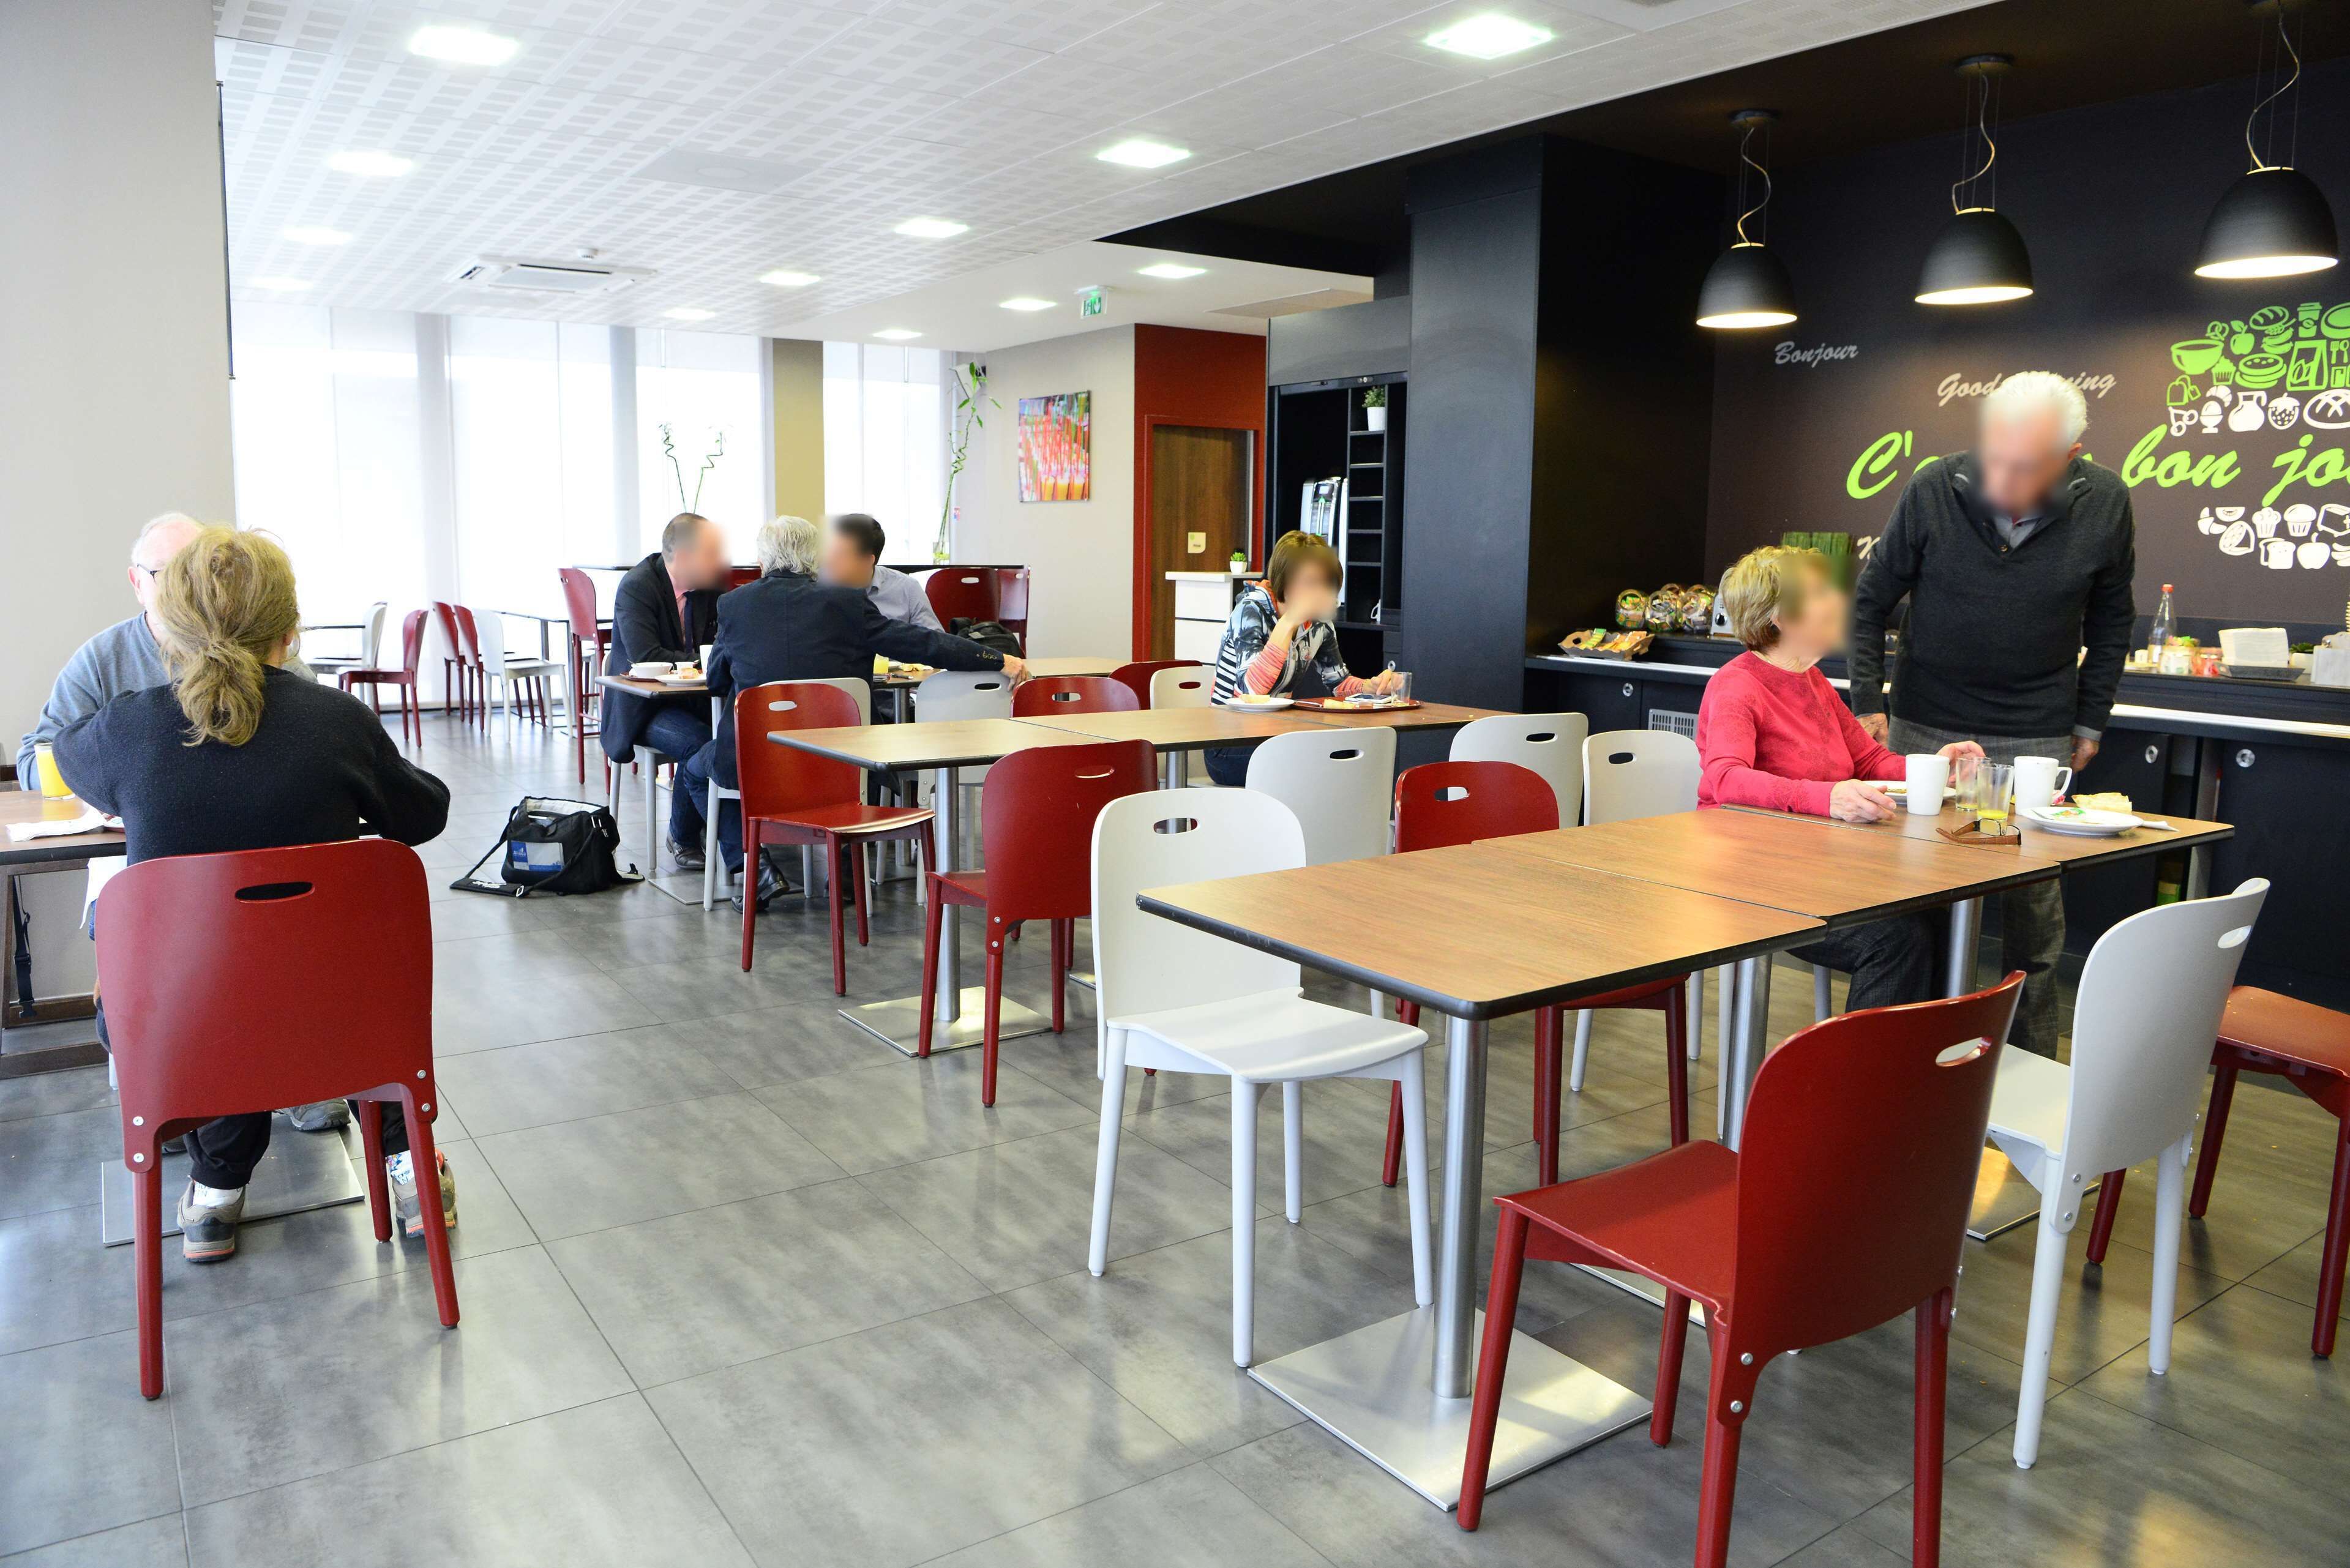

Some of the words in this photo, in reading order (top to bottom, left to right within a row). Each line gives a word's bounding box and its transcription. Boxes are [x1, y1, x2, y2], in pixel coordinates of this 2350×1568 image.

[1775, 341, 1858, 368] Bonjour
[1937, 372, 2002, 407] Good
[2120, 424, 2242, 488] bon
[2261, 433, 2350, 507] jo
